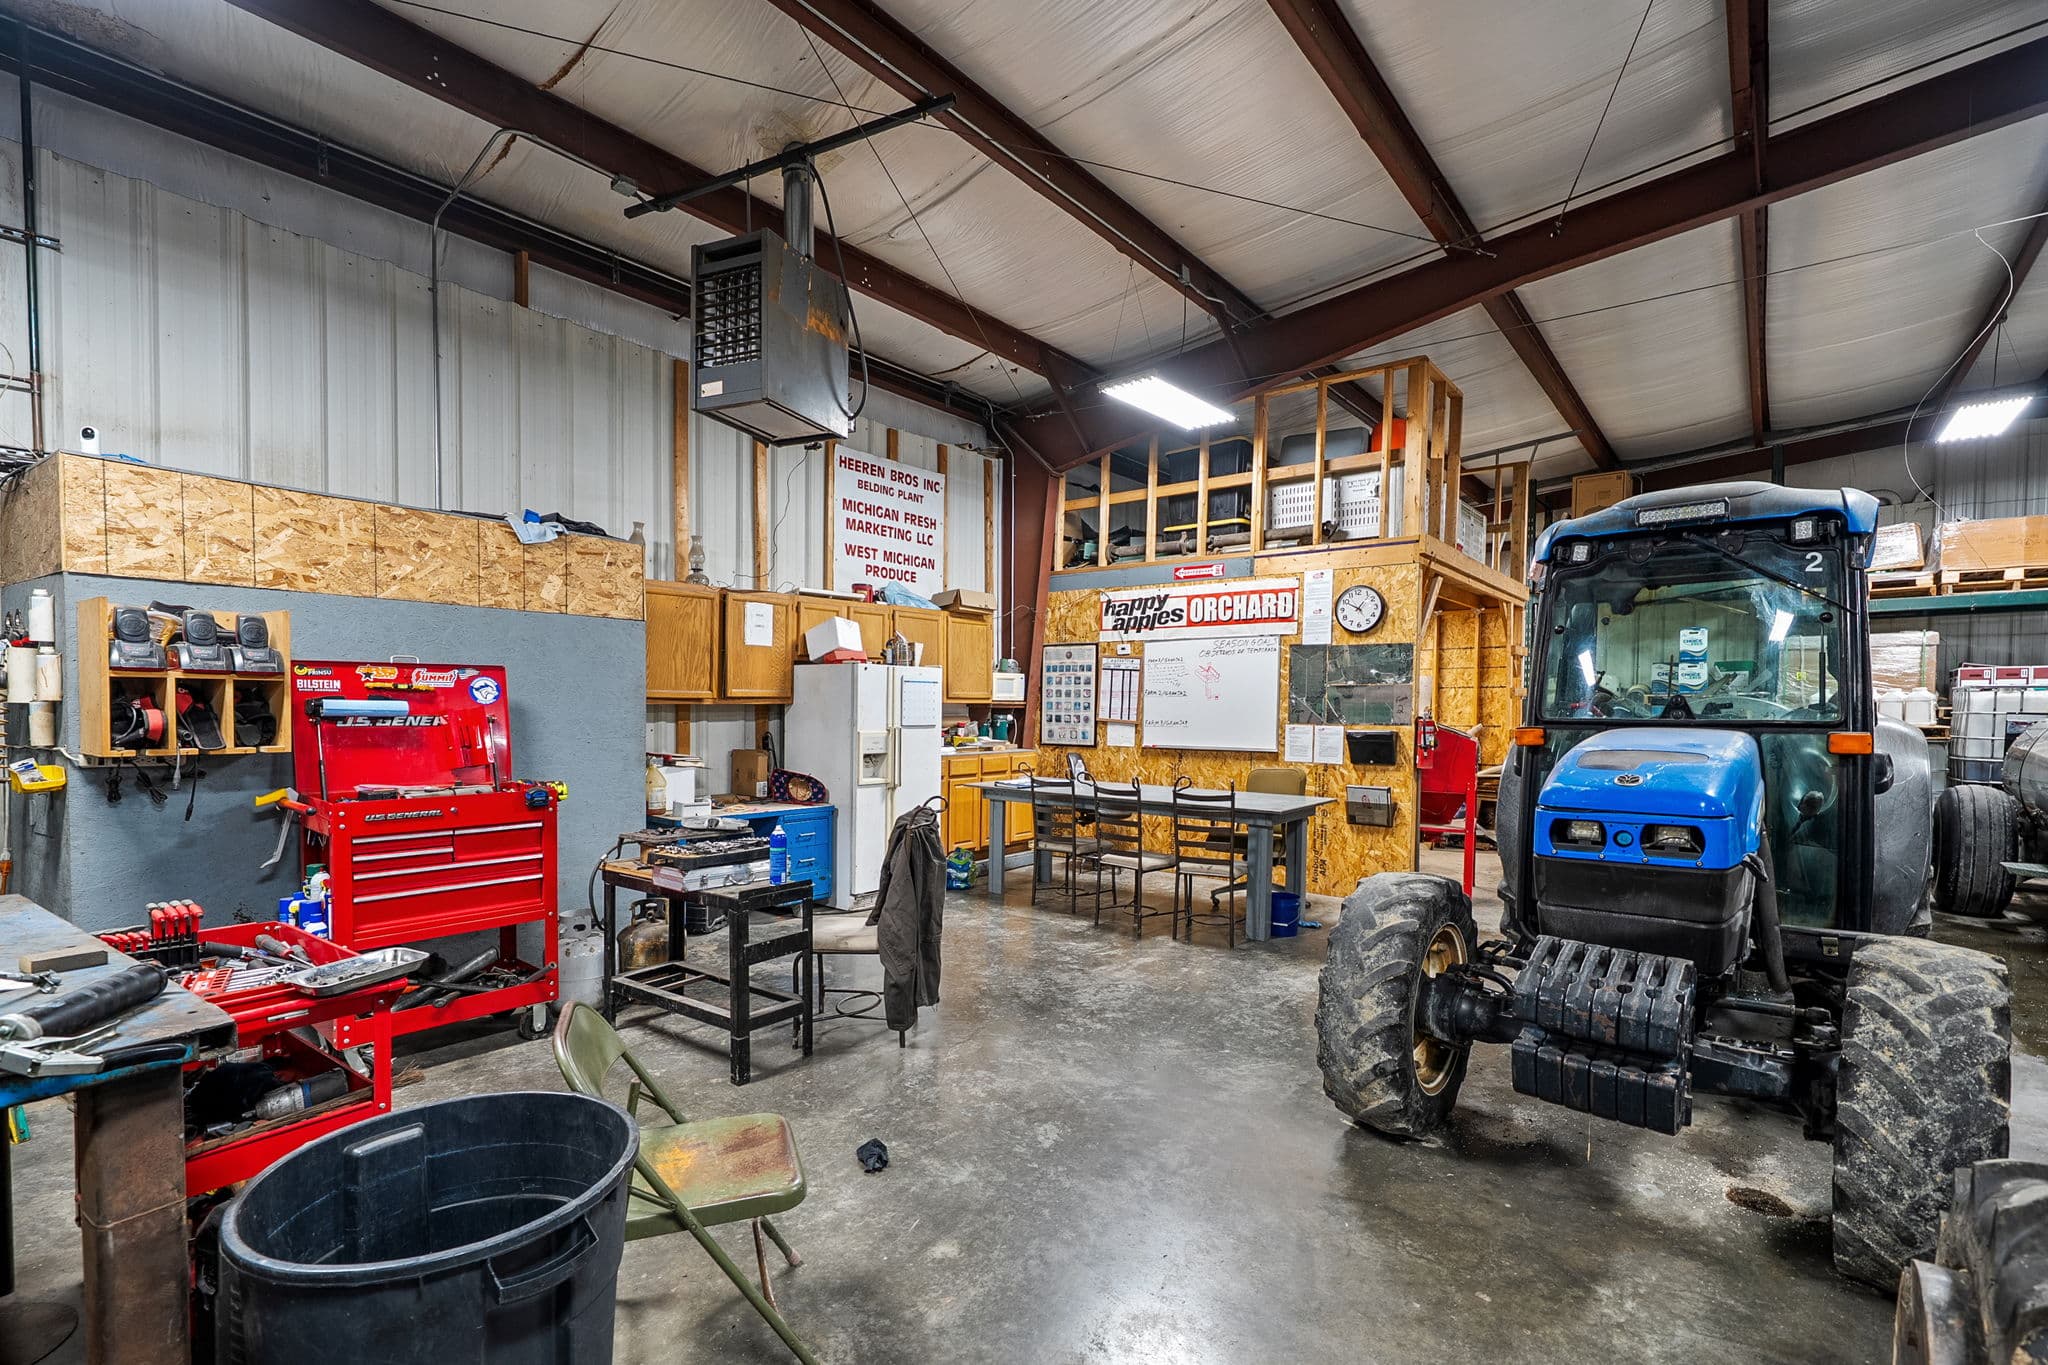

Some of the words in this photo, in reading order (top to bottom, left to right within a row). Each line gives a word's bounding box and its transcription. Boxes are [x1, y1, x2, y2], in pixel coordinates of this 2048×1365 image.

[839, 455, 885, 479] HEEREN
[890, 469, 919, 488] BROS
[923, 478, 941, 493] INC
[857, 479, 895, 497] BELDING
[897, 489, 924, 504] PLANT
[842, 498, 899, 522] MICHIGAN
[904, 512, 937, 530] FRESH
[845, 517, 912, 542] MARKETING
[916, 532, 934, 546] LLC
[844, 543, 878, 560] WEST
[883, 550, 935, 570] MICHIGAN
[1805, 551, 1823, 572] 2
[865, 564, 917, 583] PRODUCE
[1103, 593, 1170, 617] happy
[1189, 591, 1294, 624] ORCHARD
[296, 679, 341, 689] BILSTEIN
[386, 809, 443, 820] GENERAL
